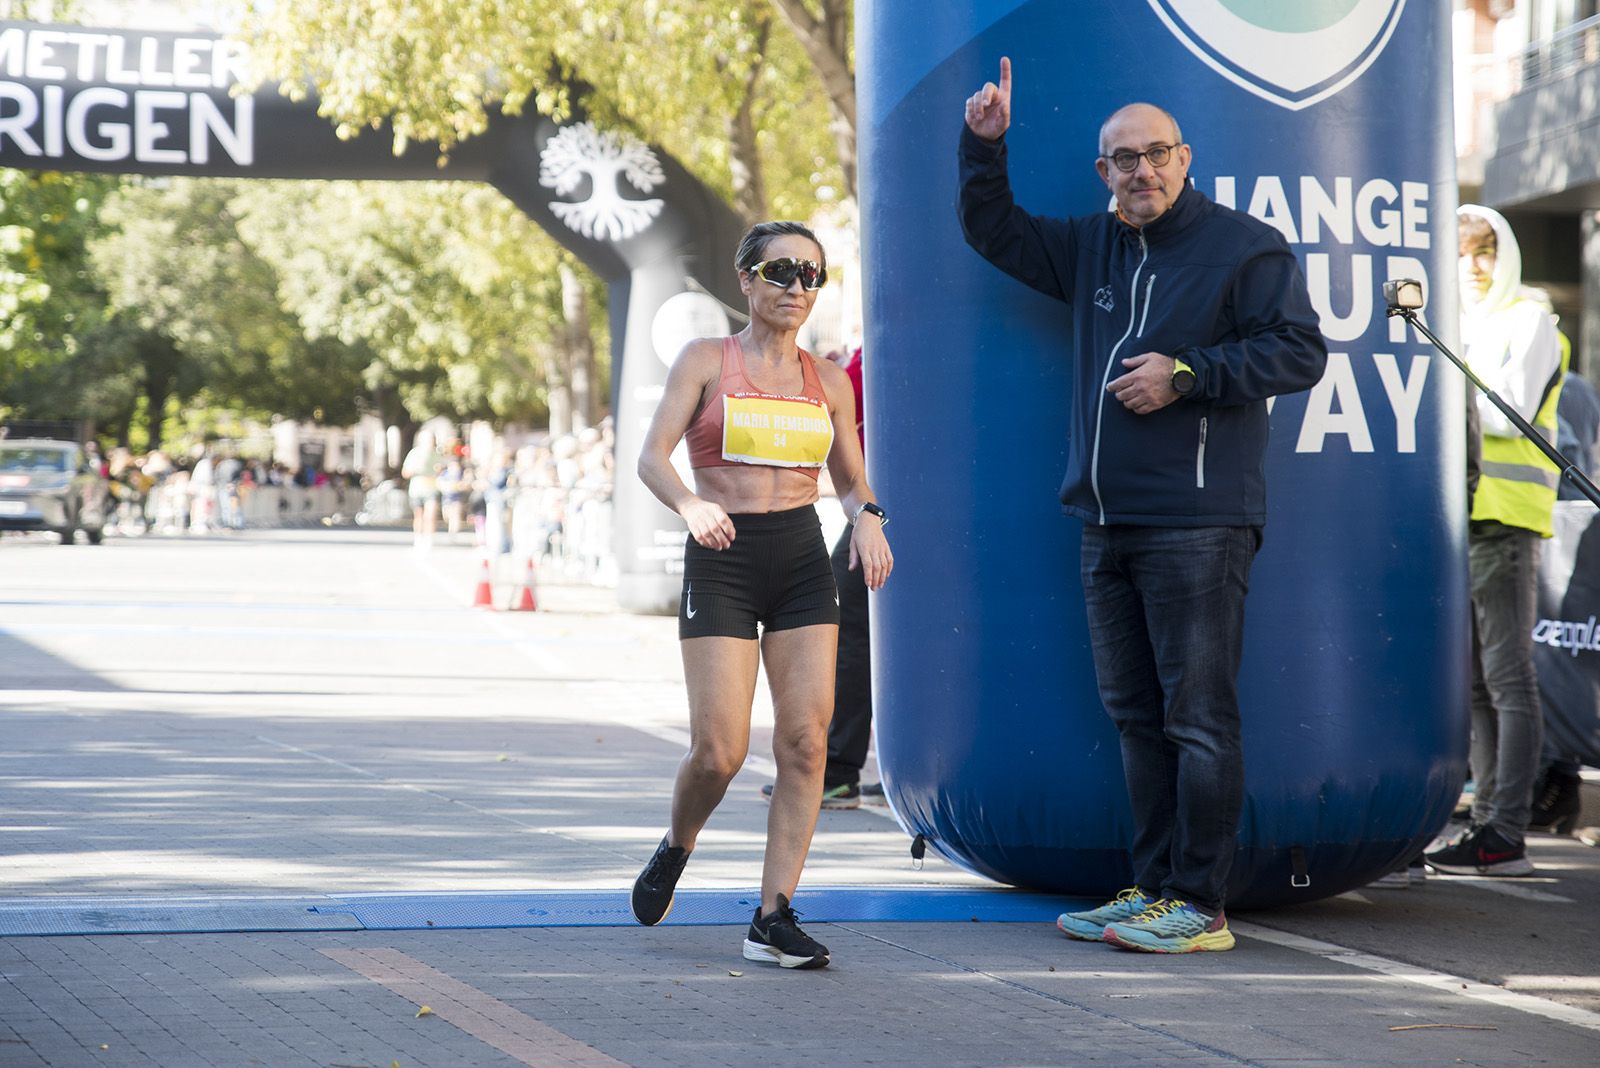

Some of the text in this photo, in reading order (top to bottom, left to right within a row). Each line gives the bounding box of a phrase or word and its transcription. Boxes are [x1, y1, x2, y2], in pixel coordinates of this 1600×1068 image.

[0, 81, 254, 165] RIGEN
[1107, 175, 1431, 249] ANGE
[773, 415, 829, 433] REMEDIOS
[1266, 353, 1431, 453] AY
[774, 433, 787, 448] 54
